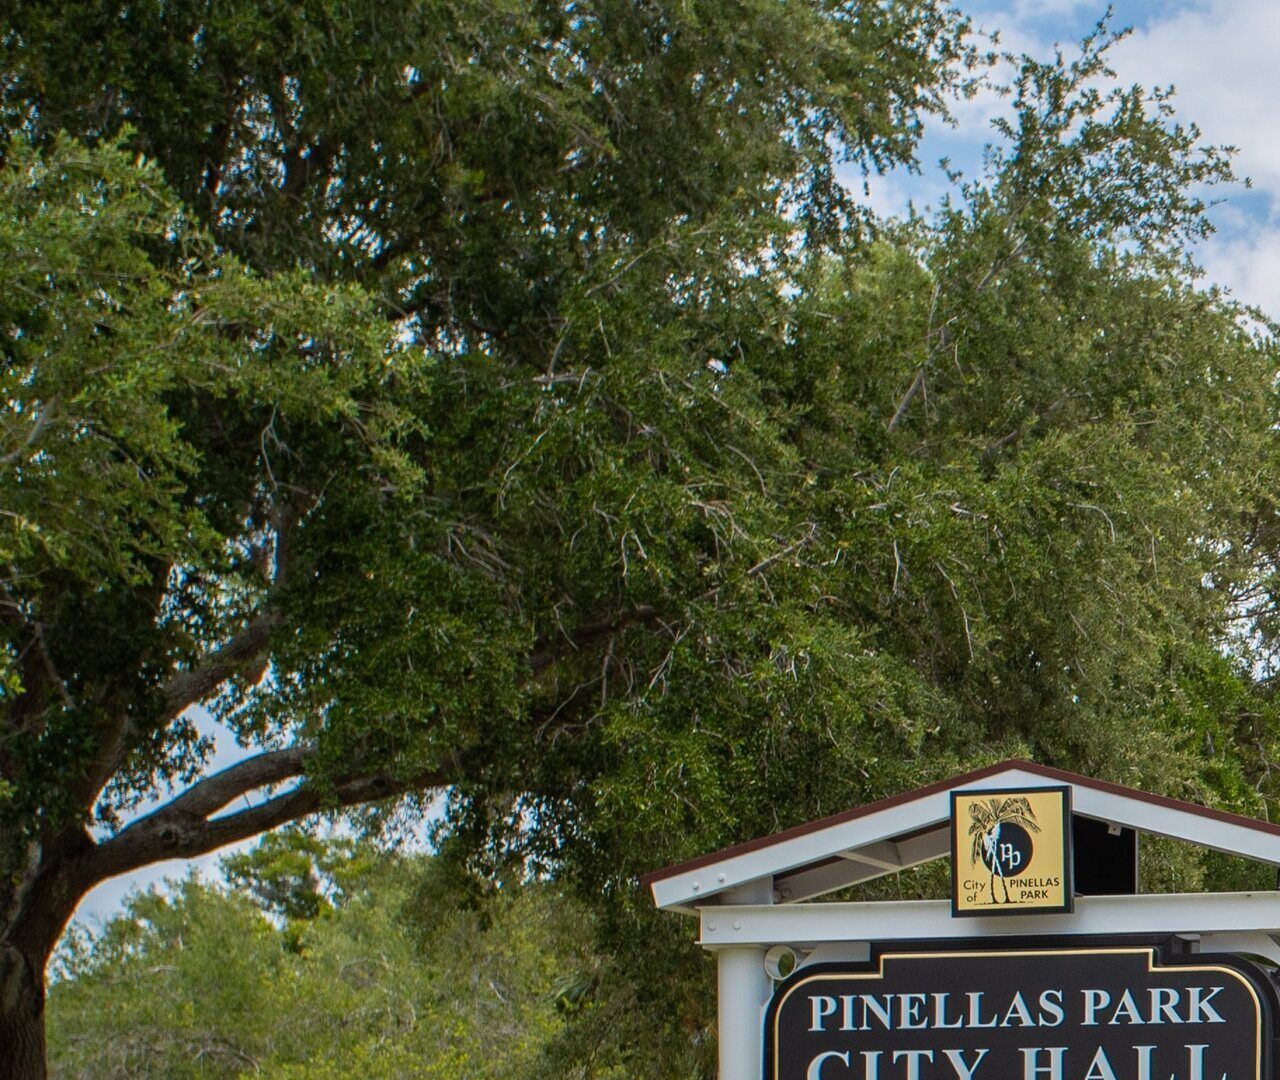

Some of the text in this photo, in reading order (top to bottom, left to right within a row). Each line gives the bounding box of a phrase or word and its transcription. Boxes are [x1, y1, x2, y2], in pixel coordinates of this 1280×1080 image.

[963, 880, 986, 893] City
[1009, 877, 1060, 888] PINELLAS
[966, 892, 978, 902] of
[1020, 890, 1049, 899] PARK
[807, 986, 1227, 1032] PINELLAS PARK
